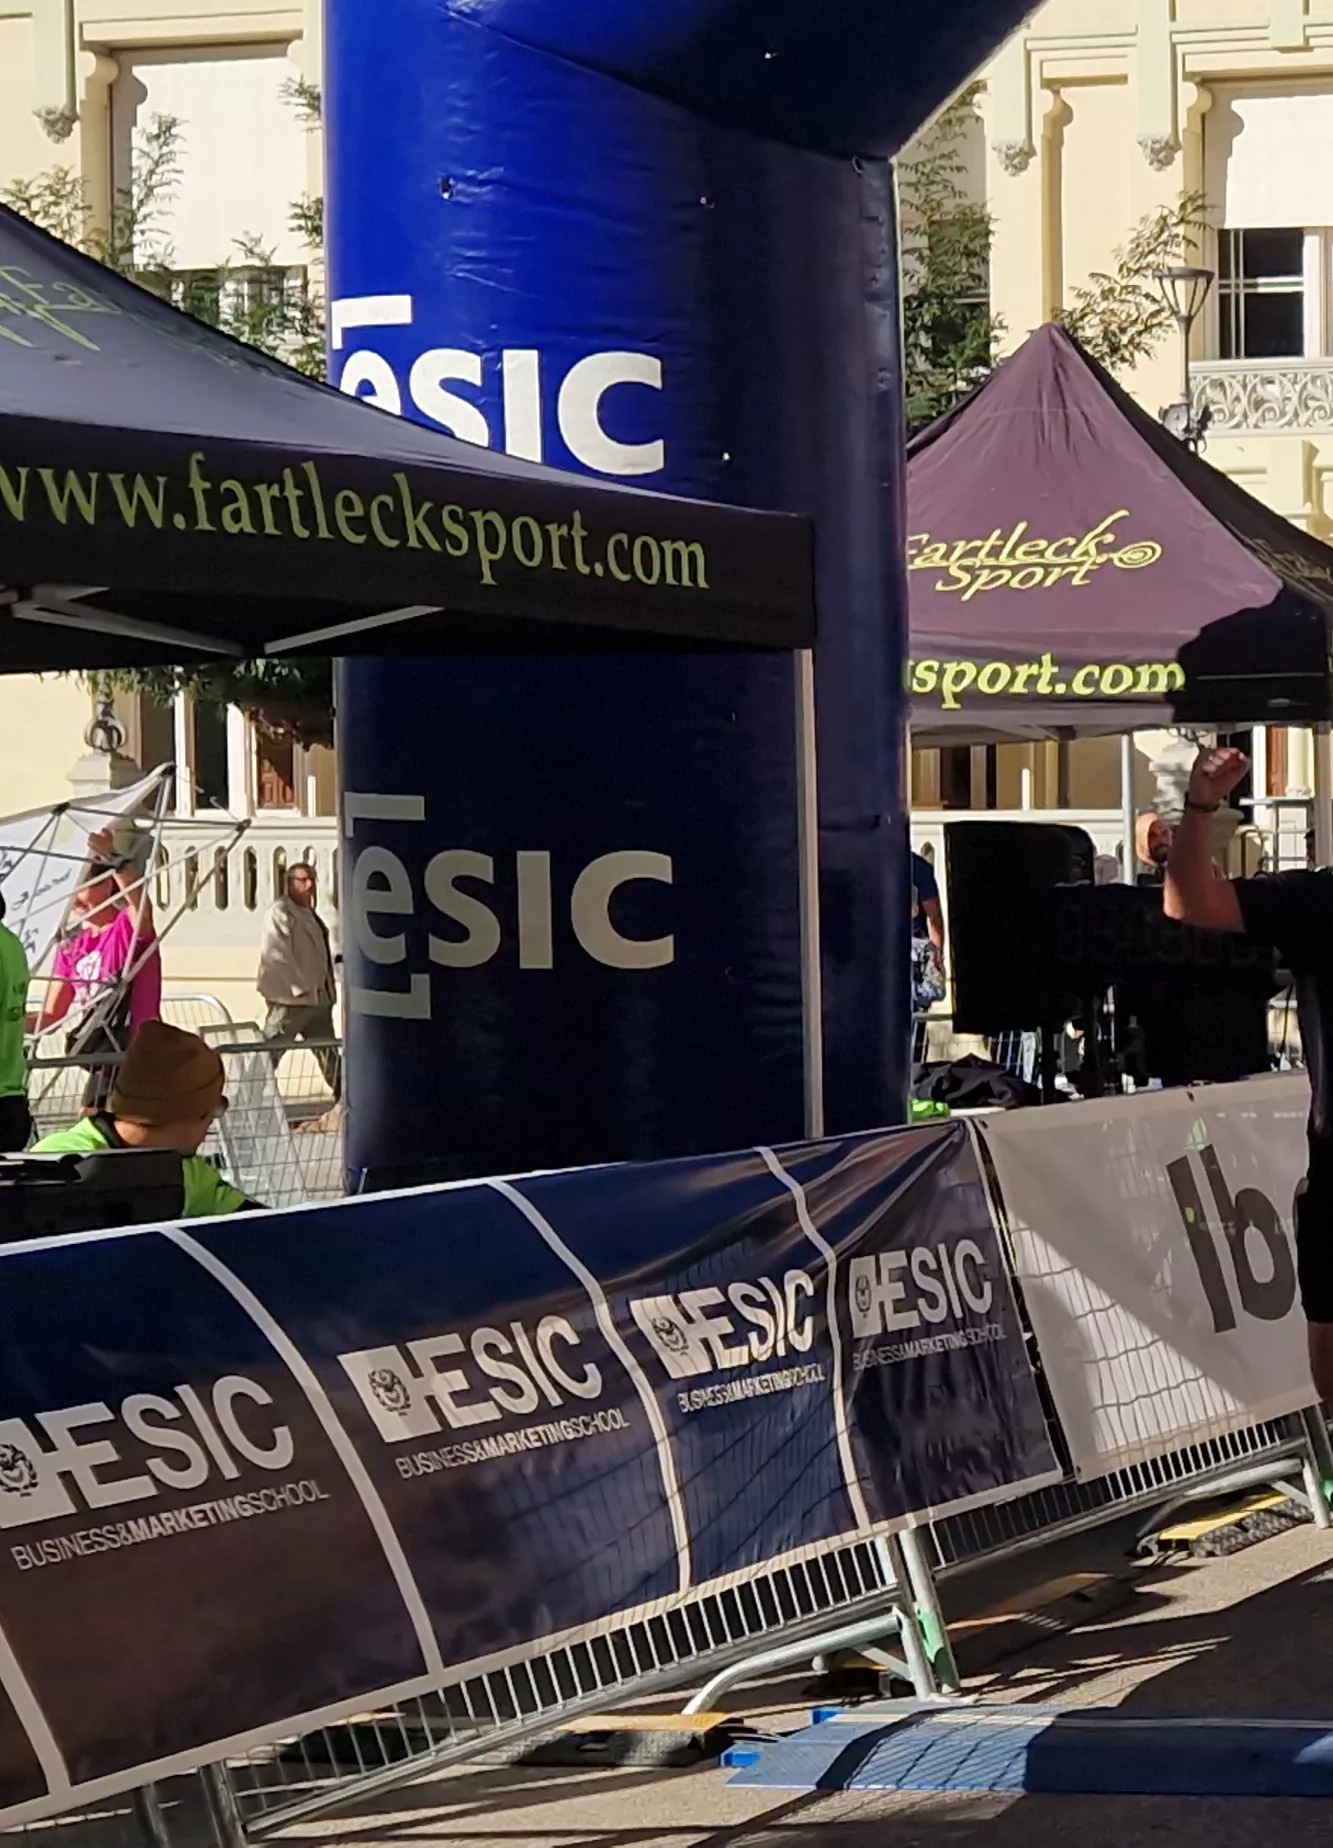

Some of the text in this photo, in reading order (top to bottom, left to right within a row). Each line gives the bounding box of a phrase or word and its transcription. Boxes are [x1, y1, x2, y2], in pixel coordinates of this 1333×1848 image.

[905, 652, 1186, 710] sport.com
[679, 1268, 814, 1370] ESIC
[879, 1238, 993, 1332] ESIC
[405, 1314, 602, 1430] ESIC
[34, 1375, 294, 1510] ESIC
